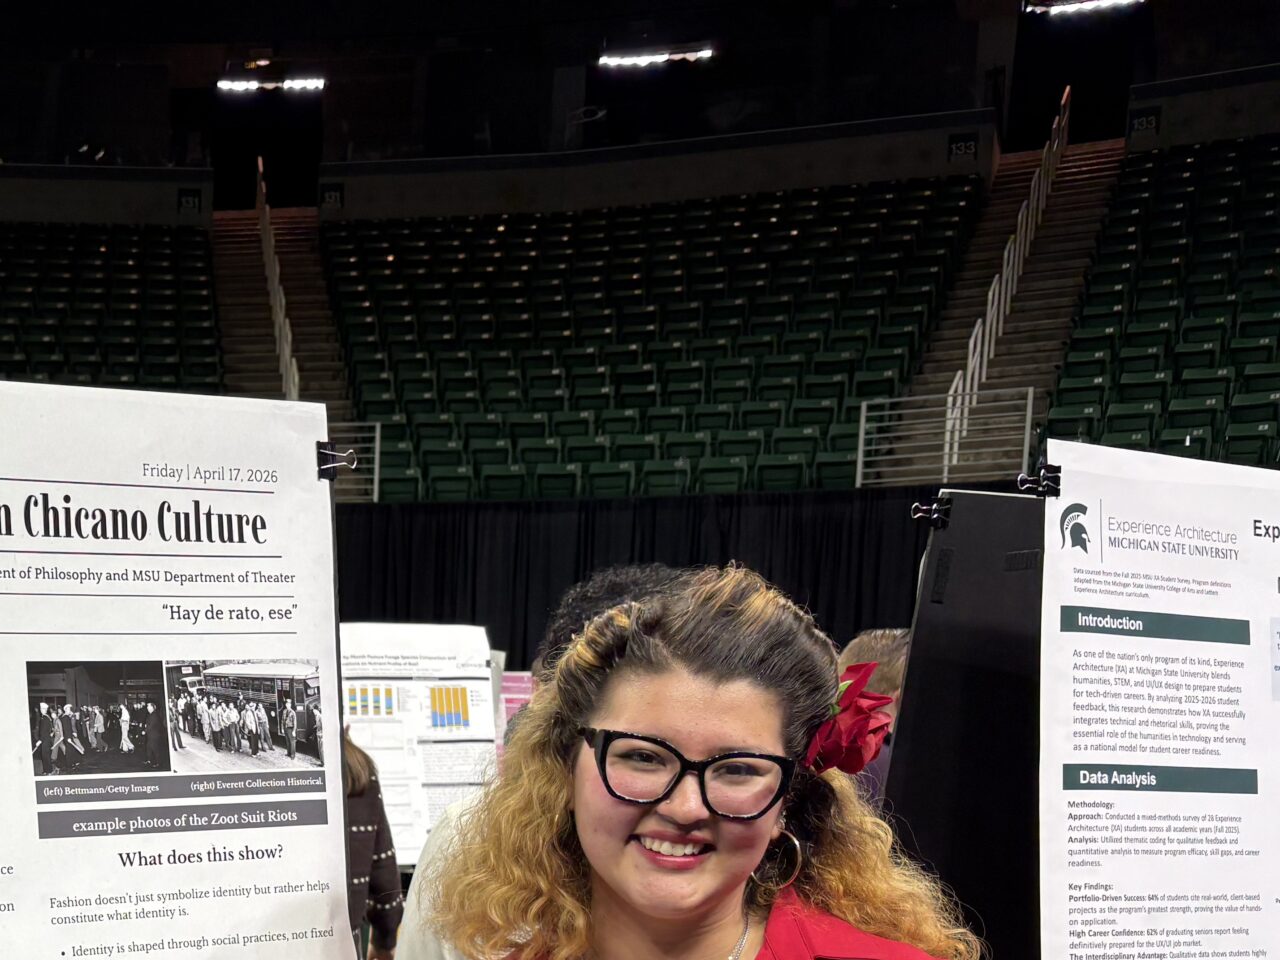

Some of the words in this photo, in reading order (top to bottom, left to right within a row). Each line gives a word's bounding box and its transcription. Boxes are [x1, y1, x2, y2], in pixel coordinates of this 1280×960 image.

[1132, 116, 1156, 130] 133
[950, 141, 975, 154] 133
[142, 463, 183, 482] Friday
[193, 466, 224, 484] April
[228, 468, 243, 482] 17,
[246, 468, 278, 483] 2026
[23, 492, 147, 541] Chicano
[157, 499, 266, 544] Culture
[1108, 516, 1171, 536] Experience
[1174, 524, 1237, 544] Architecture
[1253, 519, 1280, 543] Exp
[1108, 536, 1159, 551] MICHIGAN
[1161, 540, 1186, 554] STATE
[1188, 544, 1239, 560] UNIVERSITY
[18, 566, 32, 579] of
[34, 566, 102, 584] Philosophy
[105, 568, 128, 581] and
[132, 569, 160, 581] MSU
[163, 570, 234, 586] Department
[237, 570, 249, 582] of
[250, 570, 295, 583] Theater
[162, 603, 200, 625] “Hay
[204, 603, 223, 620] de
[228, 606, 263, 621] rato,
[268, 603, 297, 619] ese”
[1078, 612, 1142, 630] Introduction
[190, 781, 215, 792] (right)
[216, 780, 244, 789] Everett
[245, 778, 285, 788] Collection
[287, 777, 323, 786] Historical.
[1079, 770, 1108, 784] Data
[1110, 770, 1156, 788] Analysis
[43, 786, 63, 797] (left)
[64, 784, 129, 795] Bettmann/Getty
[130, 784, 159, 793] Images
[1067, 800, 1116, 810] Methodology:
[72, 817, 126, 833] example
[129, 816, 171, 832] photos
[173, 813, 187, 826] of
[188, 813, 208, 825] the
[210, 812, 238, 824] Zoot
[241, 810, 264, 823] Suit
[267, 809, 297, 821] Riots
[117, 850, 163, 867] What
[167, 849, 202, 864] does
[206, 846, 234, 862] this
[238, 843, 282, 860] show?
